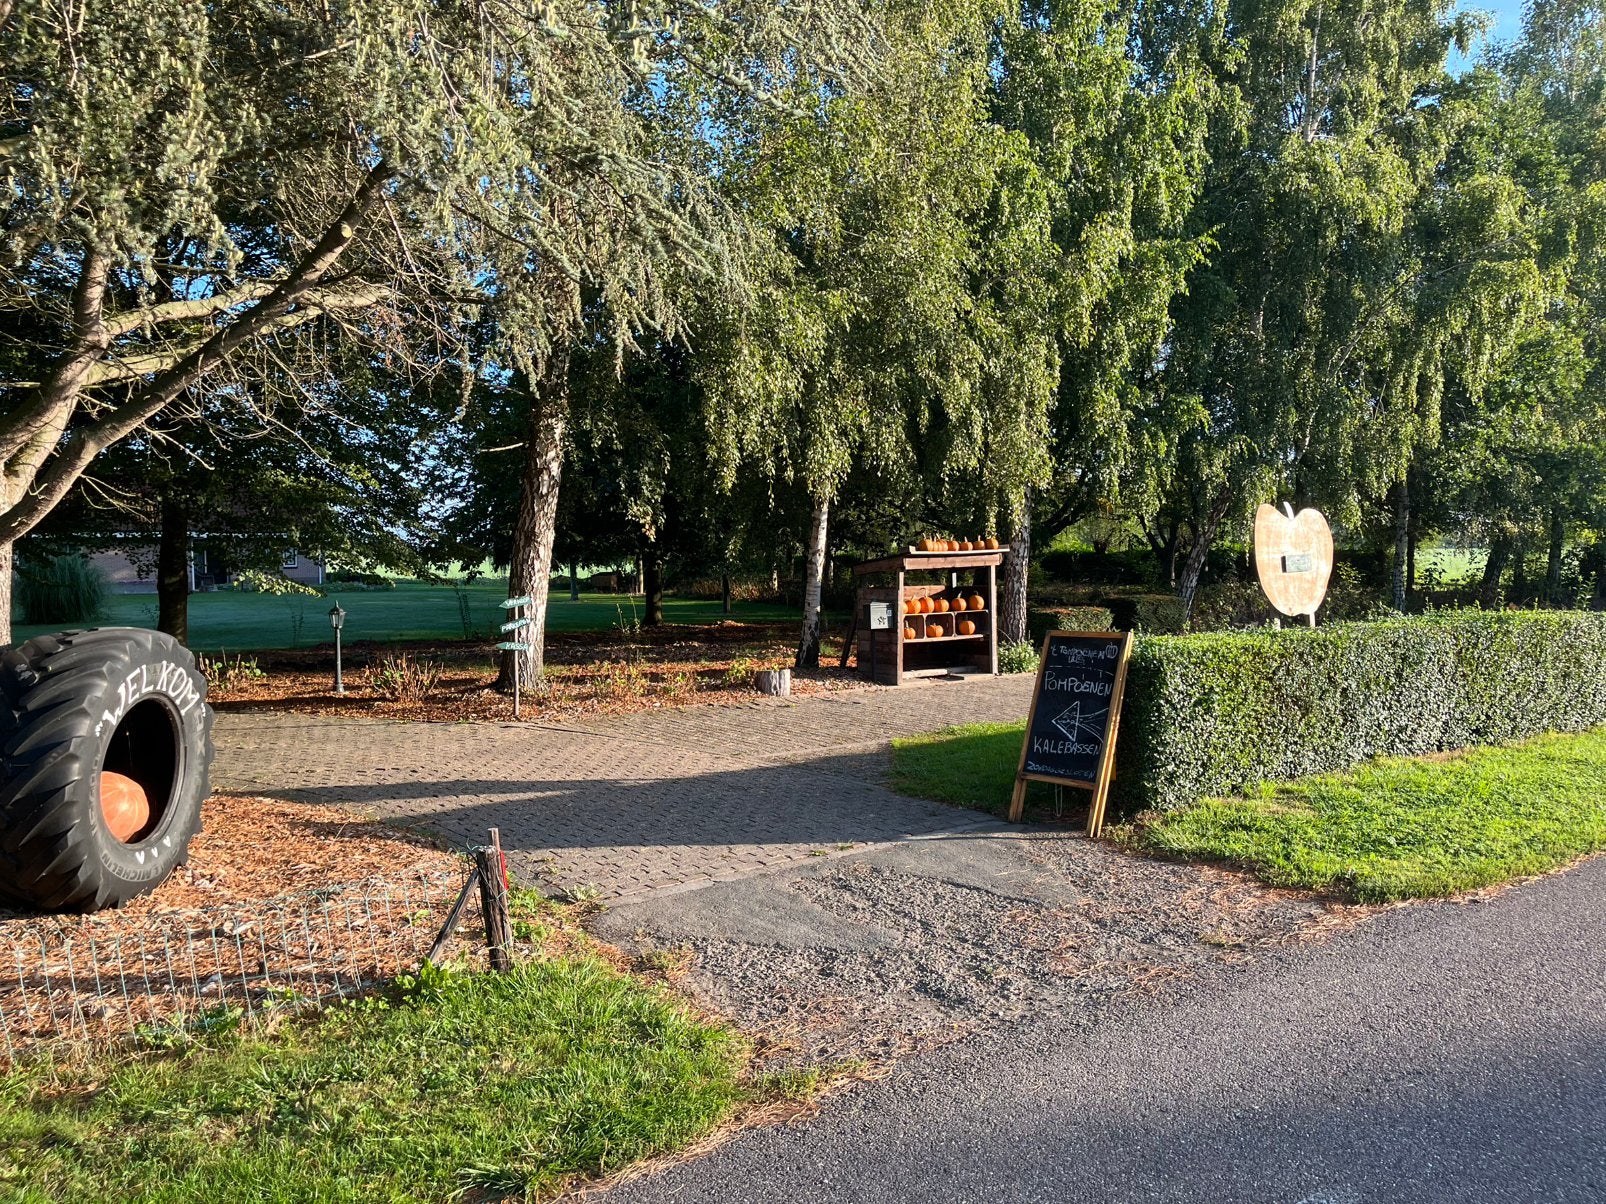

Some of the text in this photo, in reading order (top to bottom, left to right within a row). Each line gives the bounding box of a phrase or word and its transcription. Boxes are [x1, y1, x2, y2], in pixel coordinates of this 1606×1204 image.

[505, 642, 528, 650] KASSA
[1044, 670, 1113, 697] POMPOENEN
[1033, 736, 1102, 755] KALEBASSEN
[101, 852, 151, 881] MICHELIN
